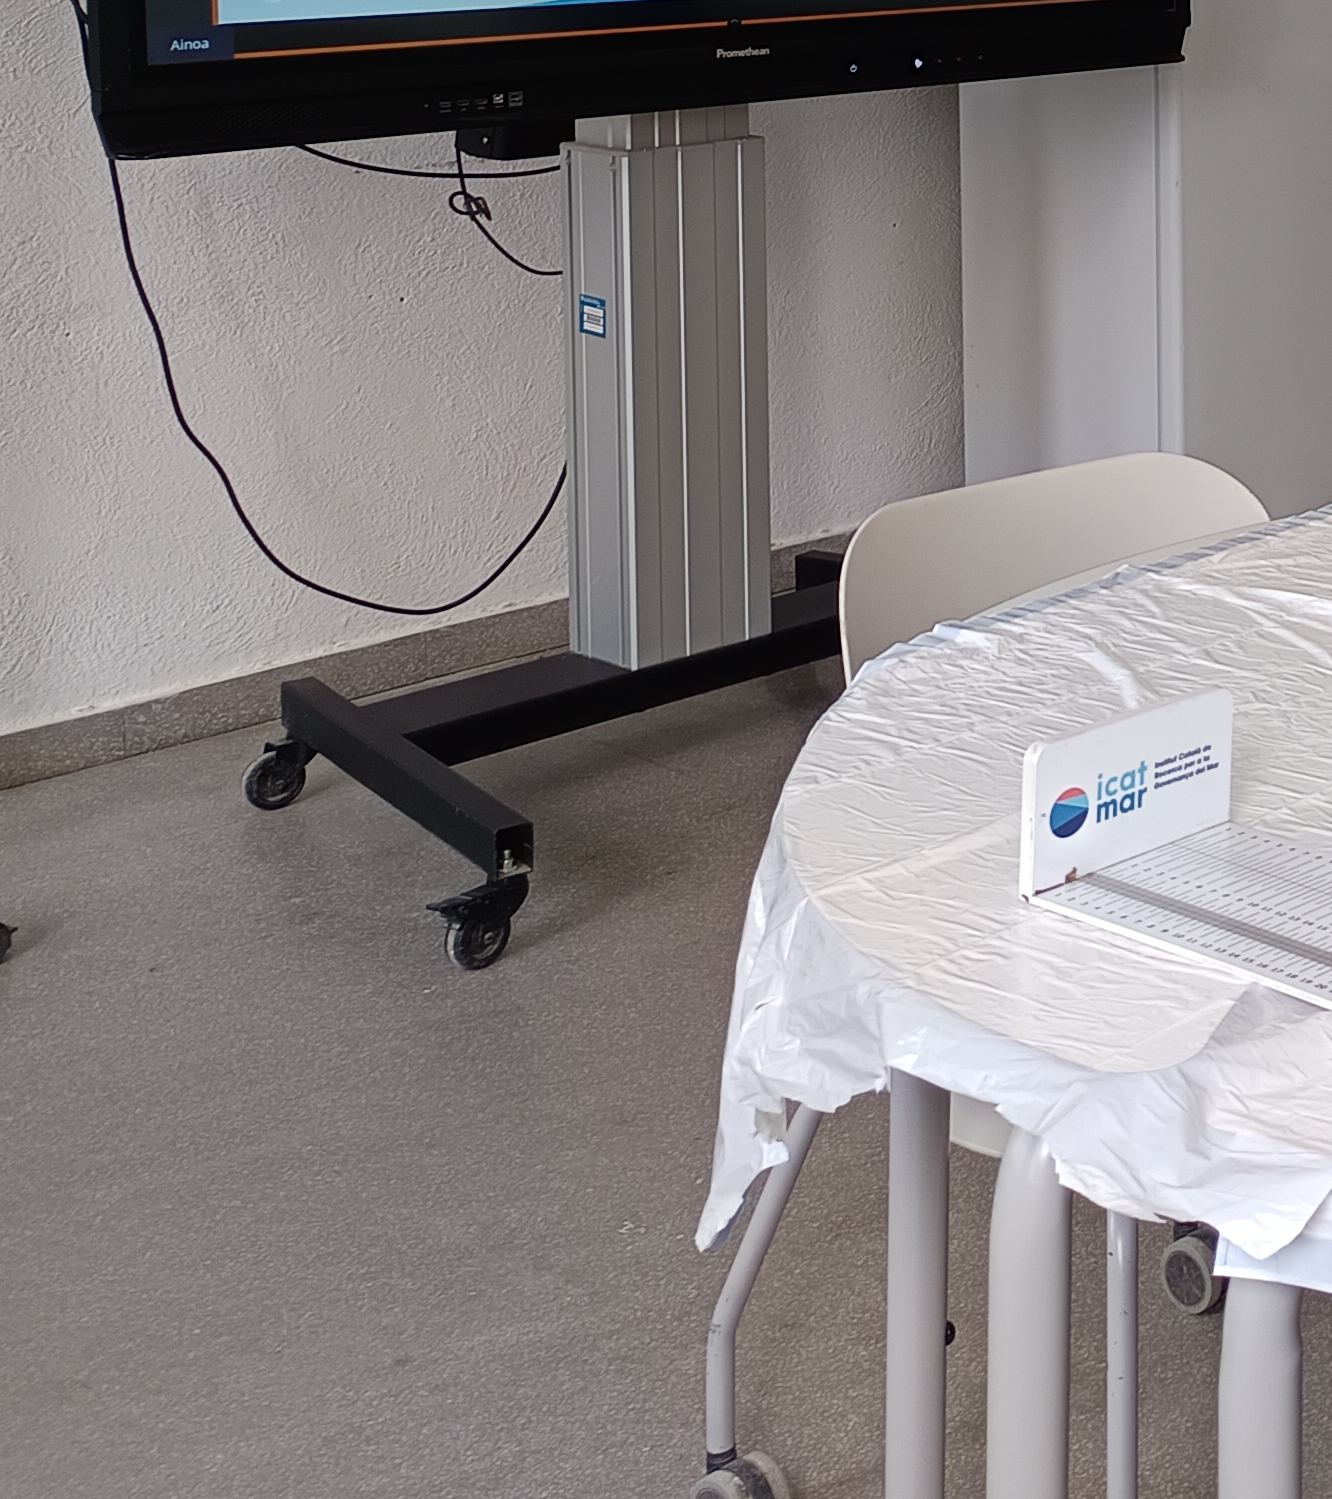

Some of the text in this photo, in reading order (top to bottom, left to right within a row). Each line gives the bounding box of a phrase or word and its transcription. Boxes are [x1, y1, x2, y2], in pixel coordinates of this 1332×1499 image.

[170, 38, 210, 52] Ainoa
[716, 46, 771, 59] Promethean
[1096, 760, 1148, 801] icat
[1096, 786, 1148, 823] mar
